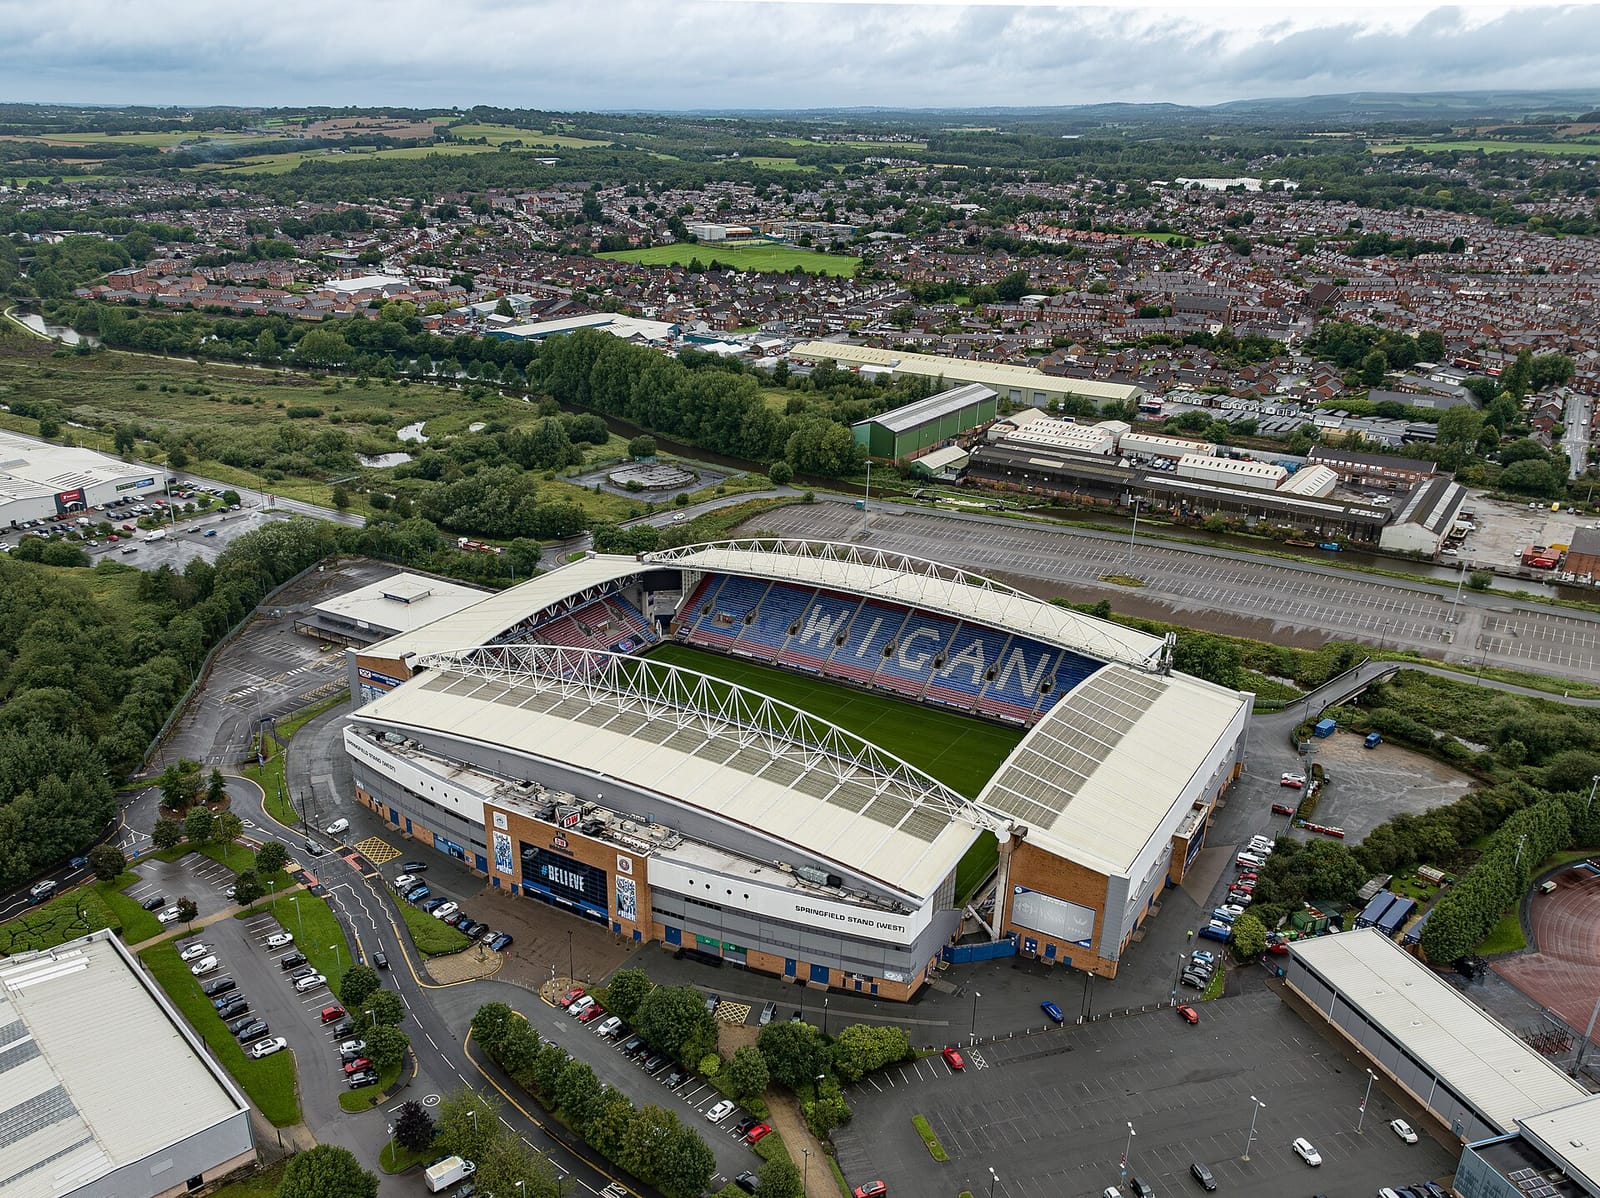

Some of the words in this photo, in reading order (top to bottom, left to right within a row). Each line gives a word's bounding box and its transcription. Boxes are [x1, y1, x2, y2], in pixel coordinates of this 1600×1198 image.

[799, 604, 1050, 698] WIGAN
[565, 814, 579, 827] DW
[541, 864, 585, 892] #BELIEVE
[795, 905, 846, 921] SPRINGFIELD
[847, 916, 874, 927] STAND
[876, 921, 905, 933] (WEST)
